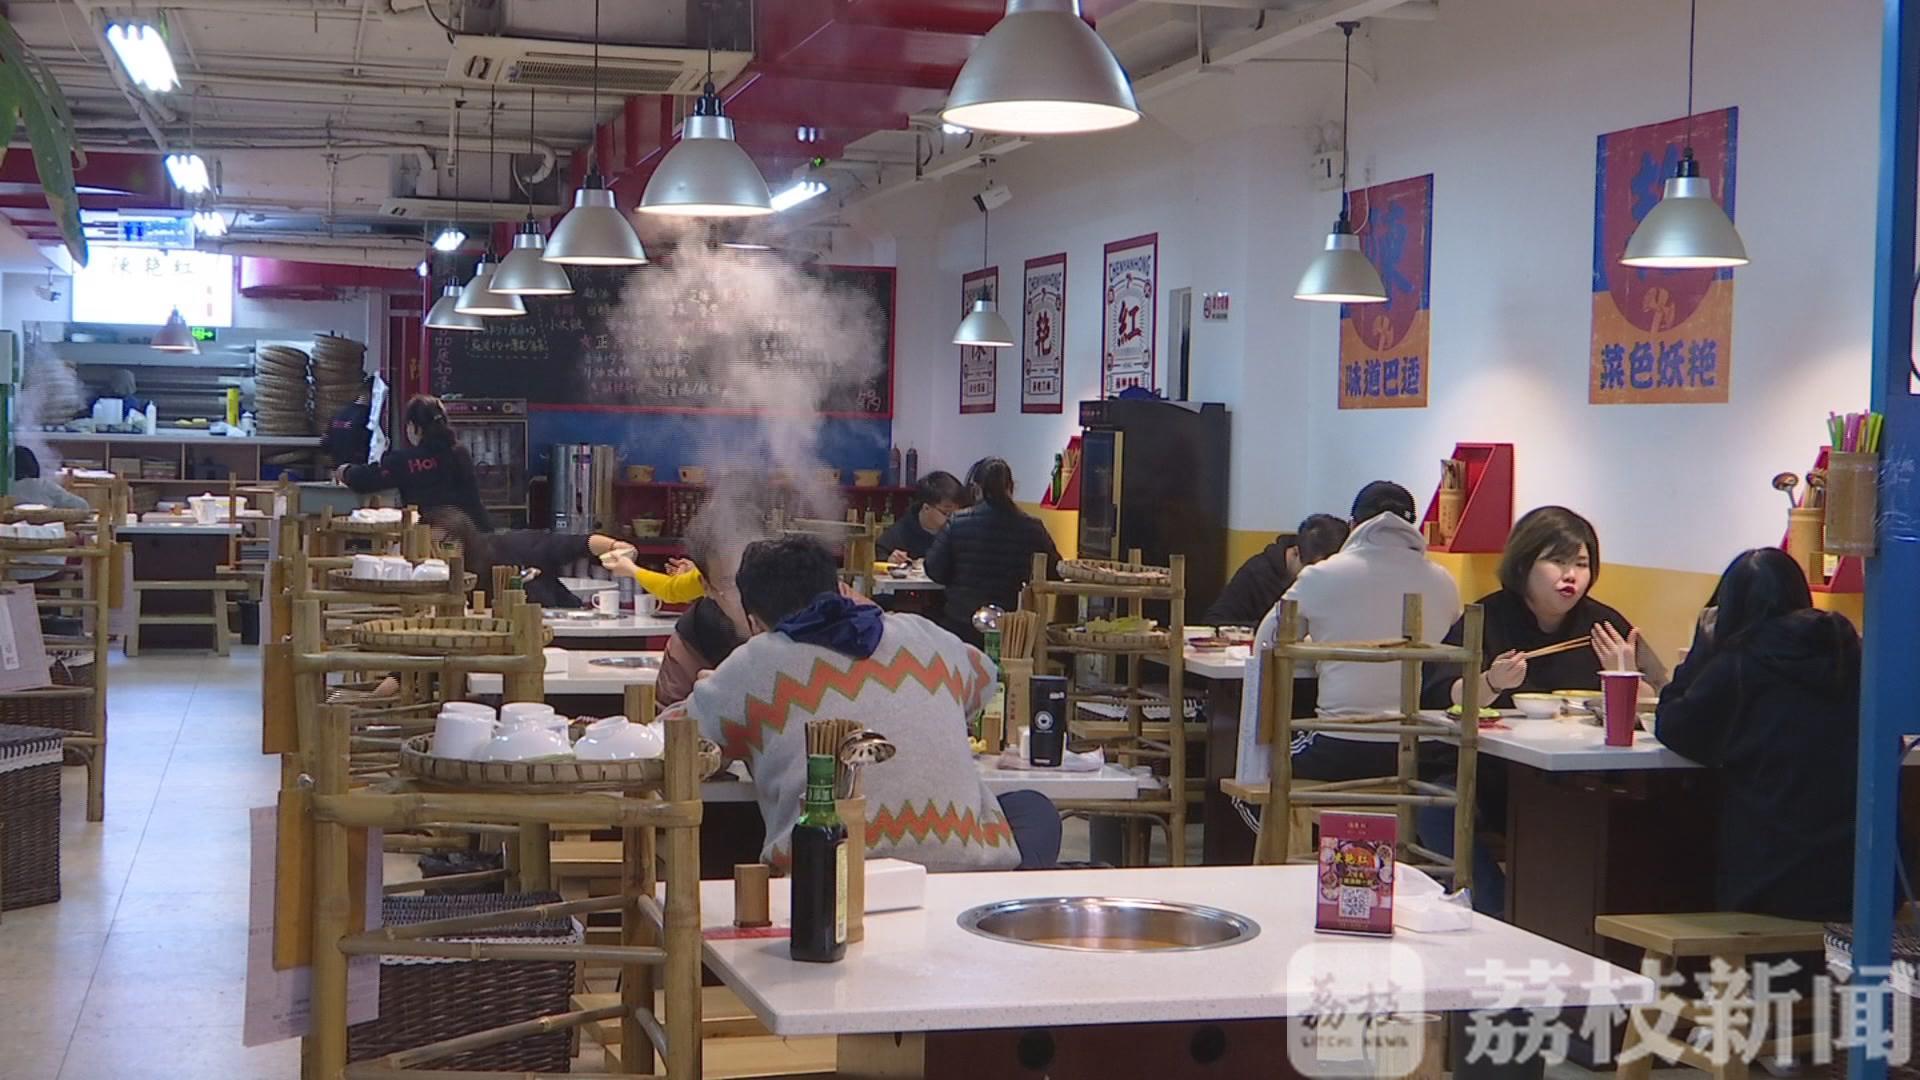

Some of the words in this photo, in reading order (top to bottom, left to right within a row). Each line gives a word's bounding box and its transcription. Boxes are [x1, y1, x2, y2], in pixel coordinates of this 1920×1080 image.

[1344, 356, 1420, 398] 味道巴适
[1600, 338, 1717, 390] 菜色妖艳
